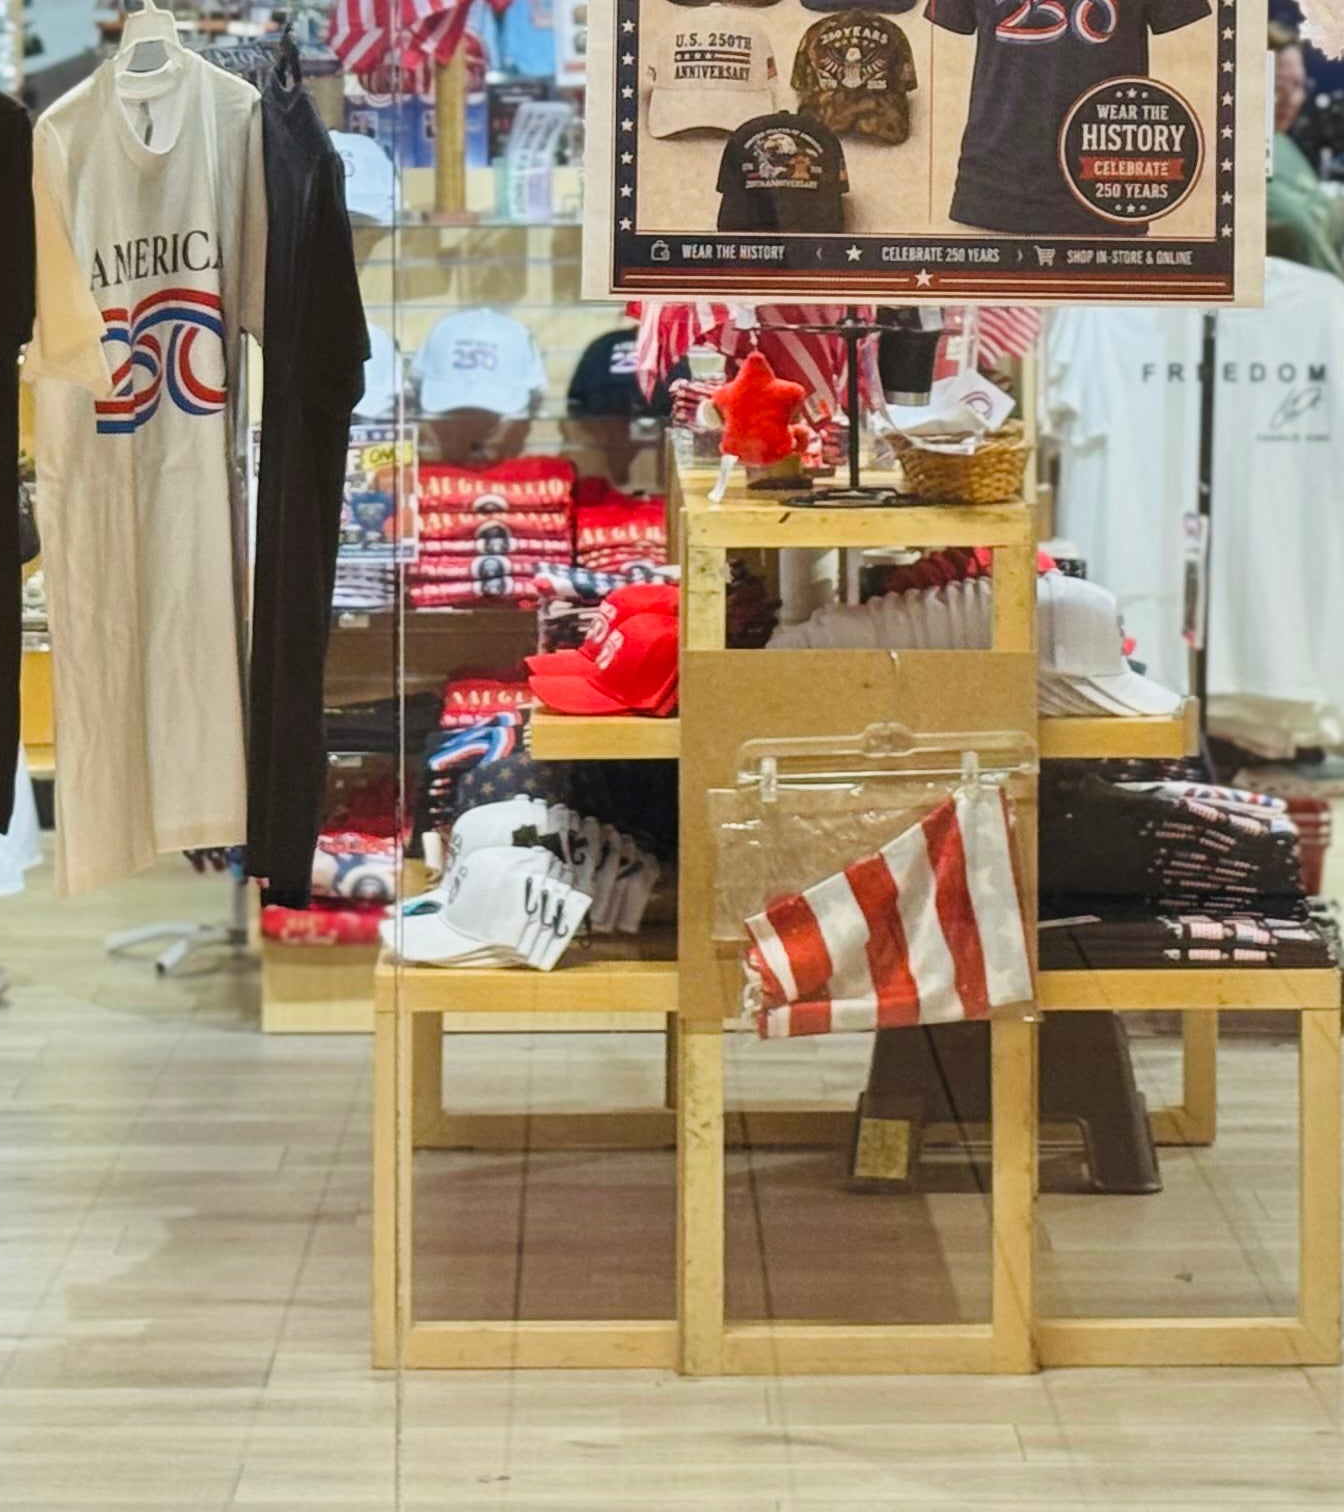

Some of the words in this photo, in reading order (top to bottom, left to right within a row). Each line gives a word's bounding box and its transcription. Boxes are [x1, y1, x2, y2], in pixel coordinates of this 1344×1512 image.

[675, 33, 703, 48] U.S.
[708, 33, 752, 50] 250TH
[843, 25, 889, 45] YEARS
[674, 65, 750, 81] ANNIVERSARY
[1096, 104, 1138, 120] WEAR
[1141, 104, 1169, 121] THE
[1081, 124, 1185, 153] HISTORY
[1094, 160, 1169, 177] CELEBRATE
[1095, 183, 1121, 199] 250
[1125, 184, 1169, 199] YEARS
[681, 244, 713, 260] WEAR
[716, 244, 737, 260] THE
[739, 245, 786, 261] HISTORY
[882, 246, 943, 262] CELEBRATE
[944, 248, 966, 262] 250
[967, 248, 1001, 263] YEARS
[1066, 249, 1094, 264] SHOP
[1096, 250, 1143, 265] IN-STORE
[1145, 250, 1154, 265] &
[1156, 250, 1194, 266] ONLINE
